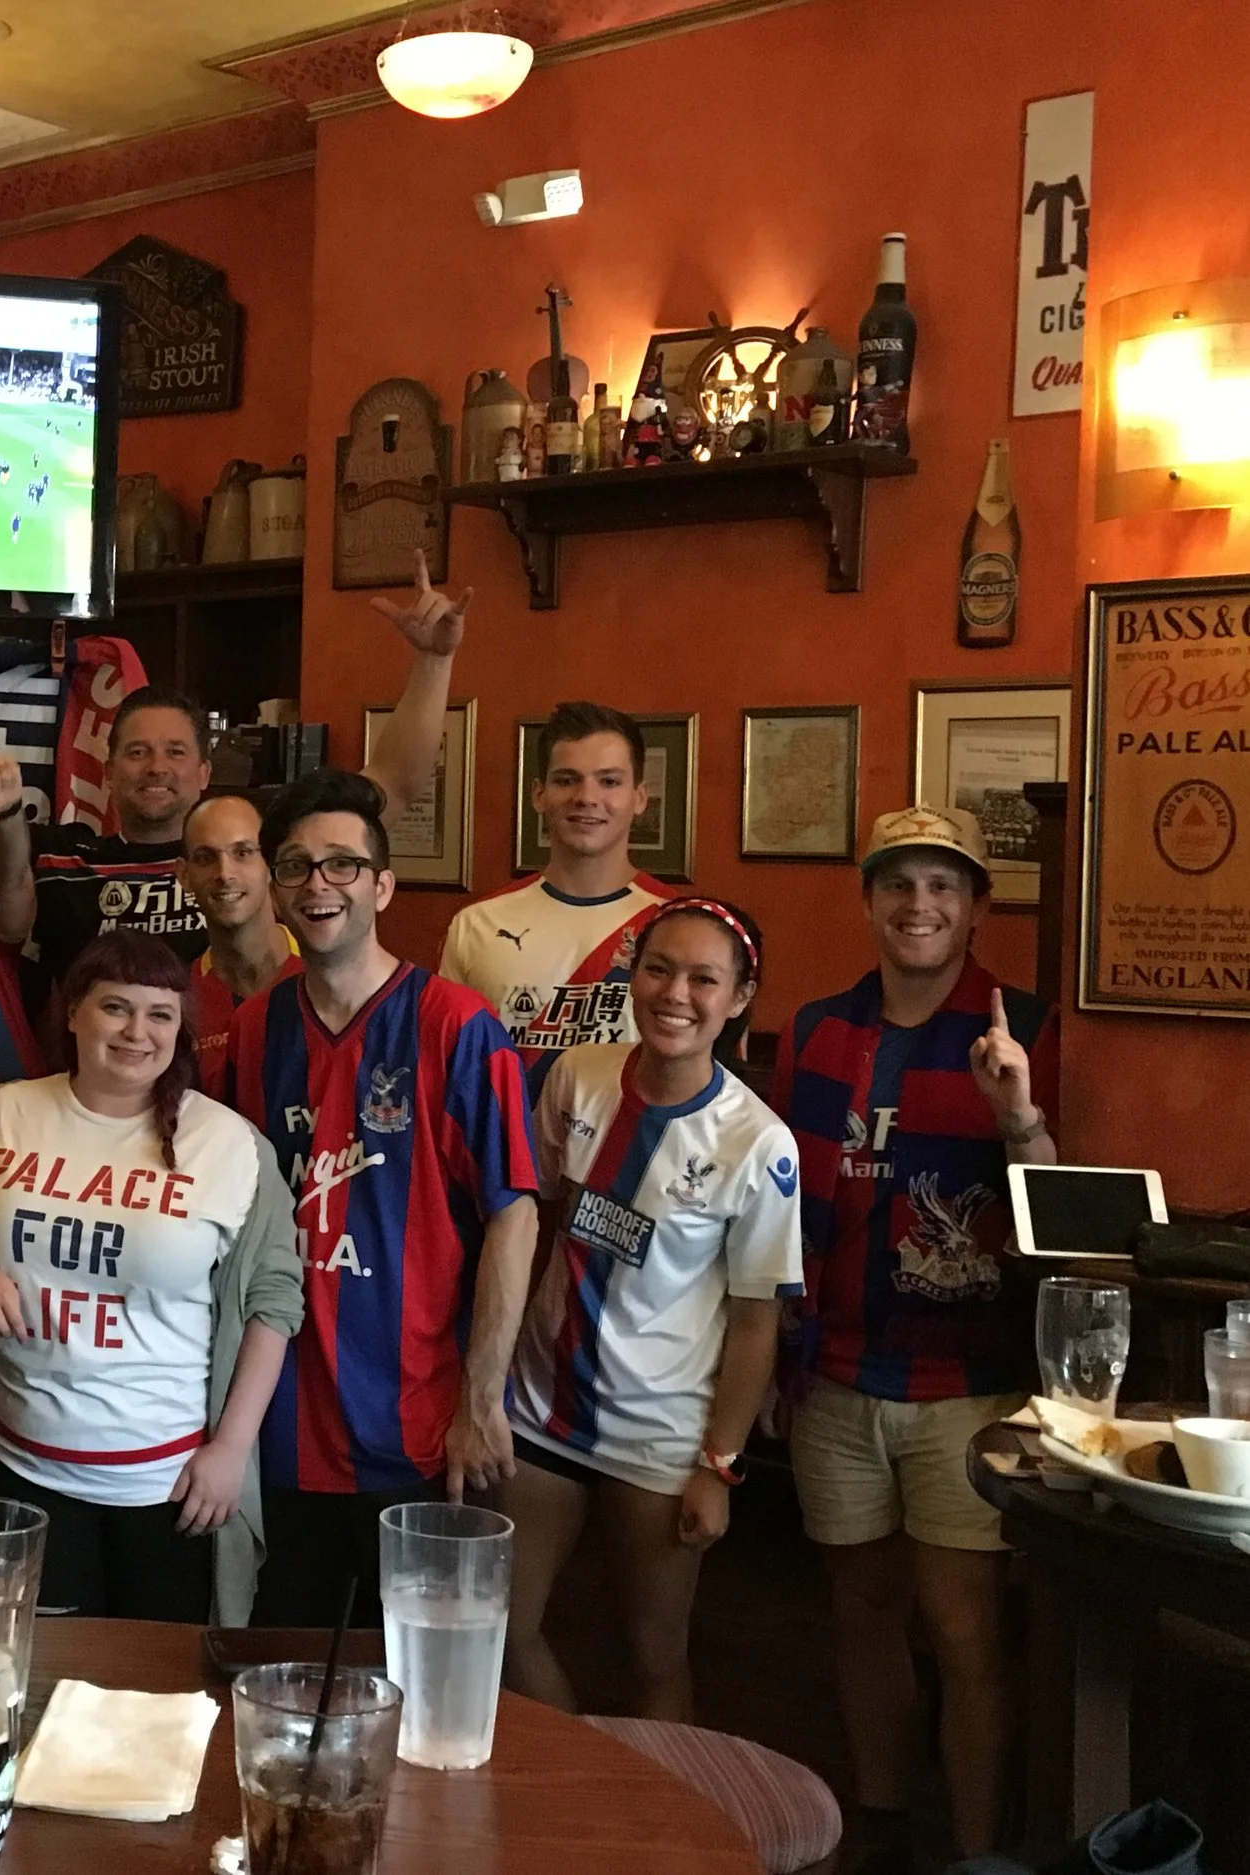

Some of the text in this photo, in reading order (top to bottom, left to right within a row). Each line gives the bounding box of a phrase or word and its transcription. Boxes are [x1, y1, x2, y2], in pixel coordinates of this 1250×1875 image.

[154, 342, 217, 367] IRISH
[148, 364, 225, 390] STOUT
[1032, 356, 1084, 391] QUA
[961, 579, 1015, 596] MAGNERS
[1116, 606, 1207, 645] BASS
[1212, 604, 1236, 639] &
[1124, 666, 1250, 720] Bass
[1117, 731, 1202, 754] PALE
[1135, 949, 1250, 963] IMPORTED FROM
[508, 1025, 624, 1047] ManBetX
[573, 1208, 641, 1254] ROBBINS
[579, 1190, 651, 1237] NORDOFF
[11, 1208, 125, 1278] FOR
[24, 1286, 126, 1349] IFE
